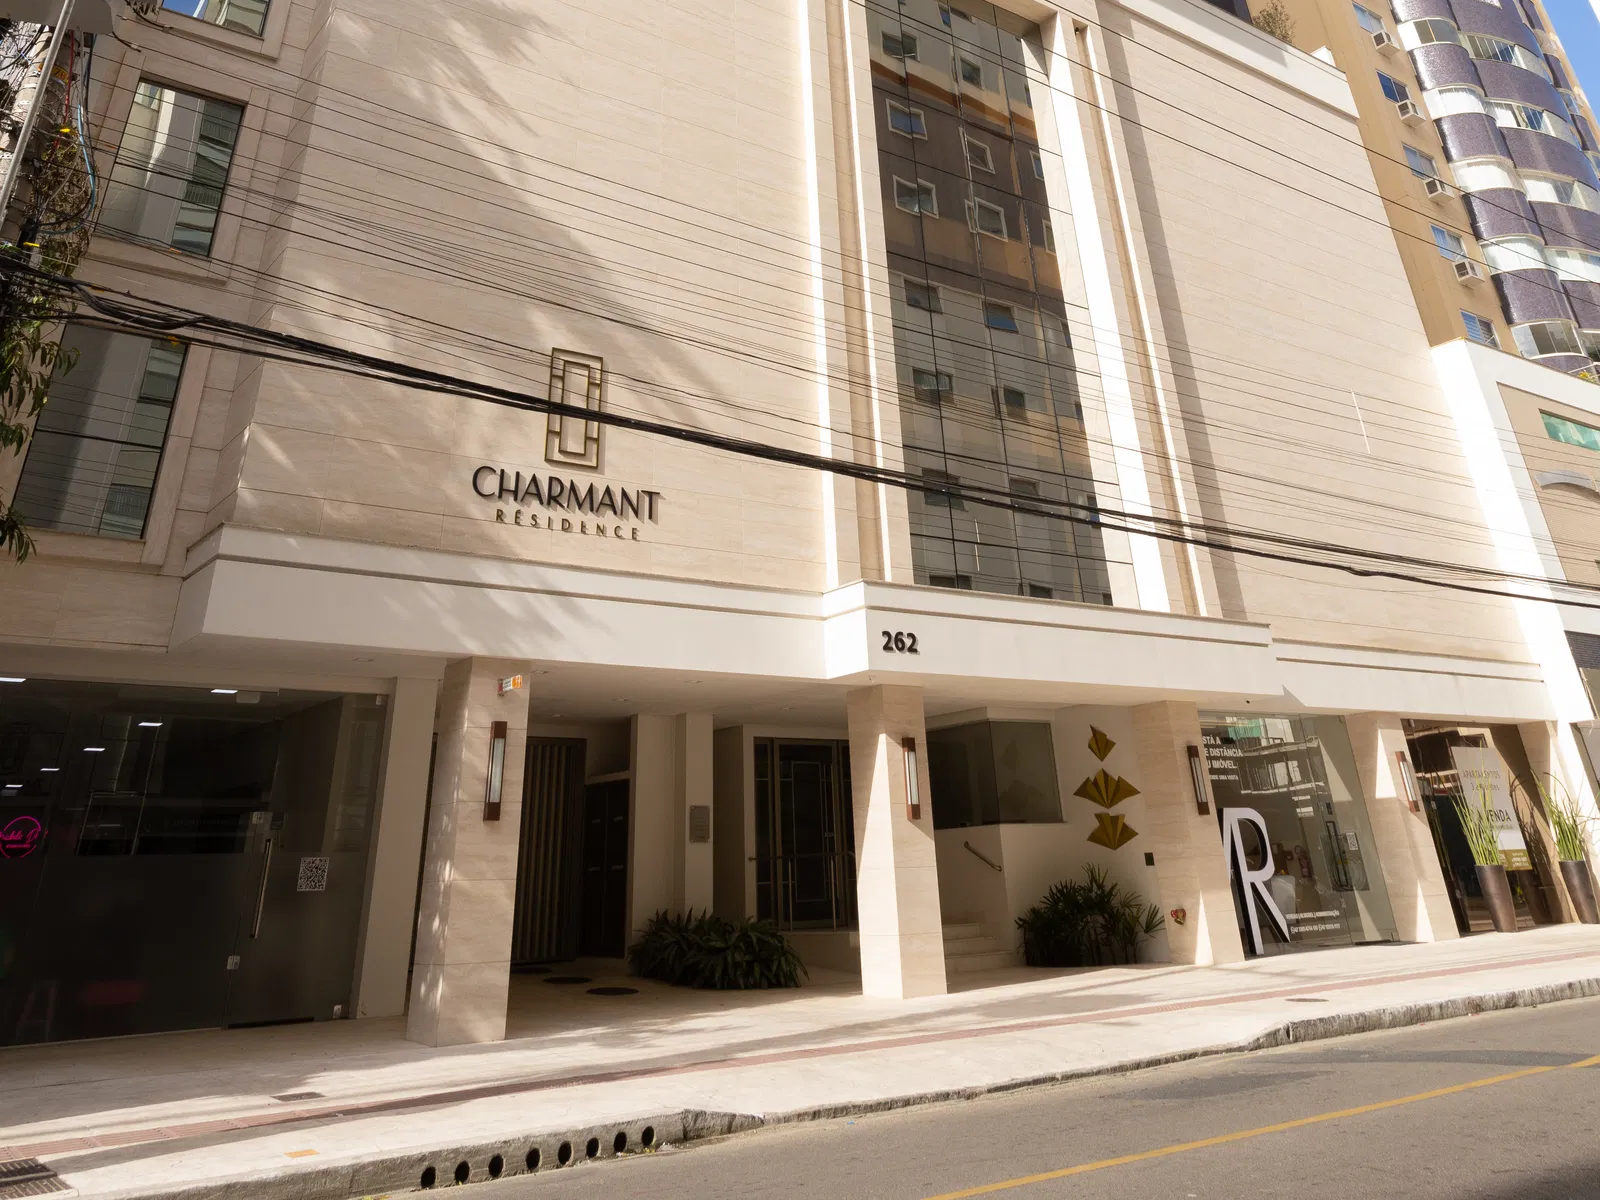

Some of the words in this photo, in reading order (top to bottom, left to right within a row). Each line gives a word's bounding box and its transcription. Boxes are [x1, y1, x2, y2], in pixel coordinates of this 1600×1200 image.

[472, 465, 661, 520] CHARMANT
[496, 508, 639, 541] RÉSIDENCE
[881, 630, 919, 653] 262
[1210, 746, 1243, 757] DISTÂNCIA
